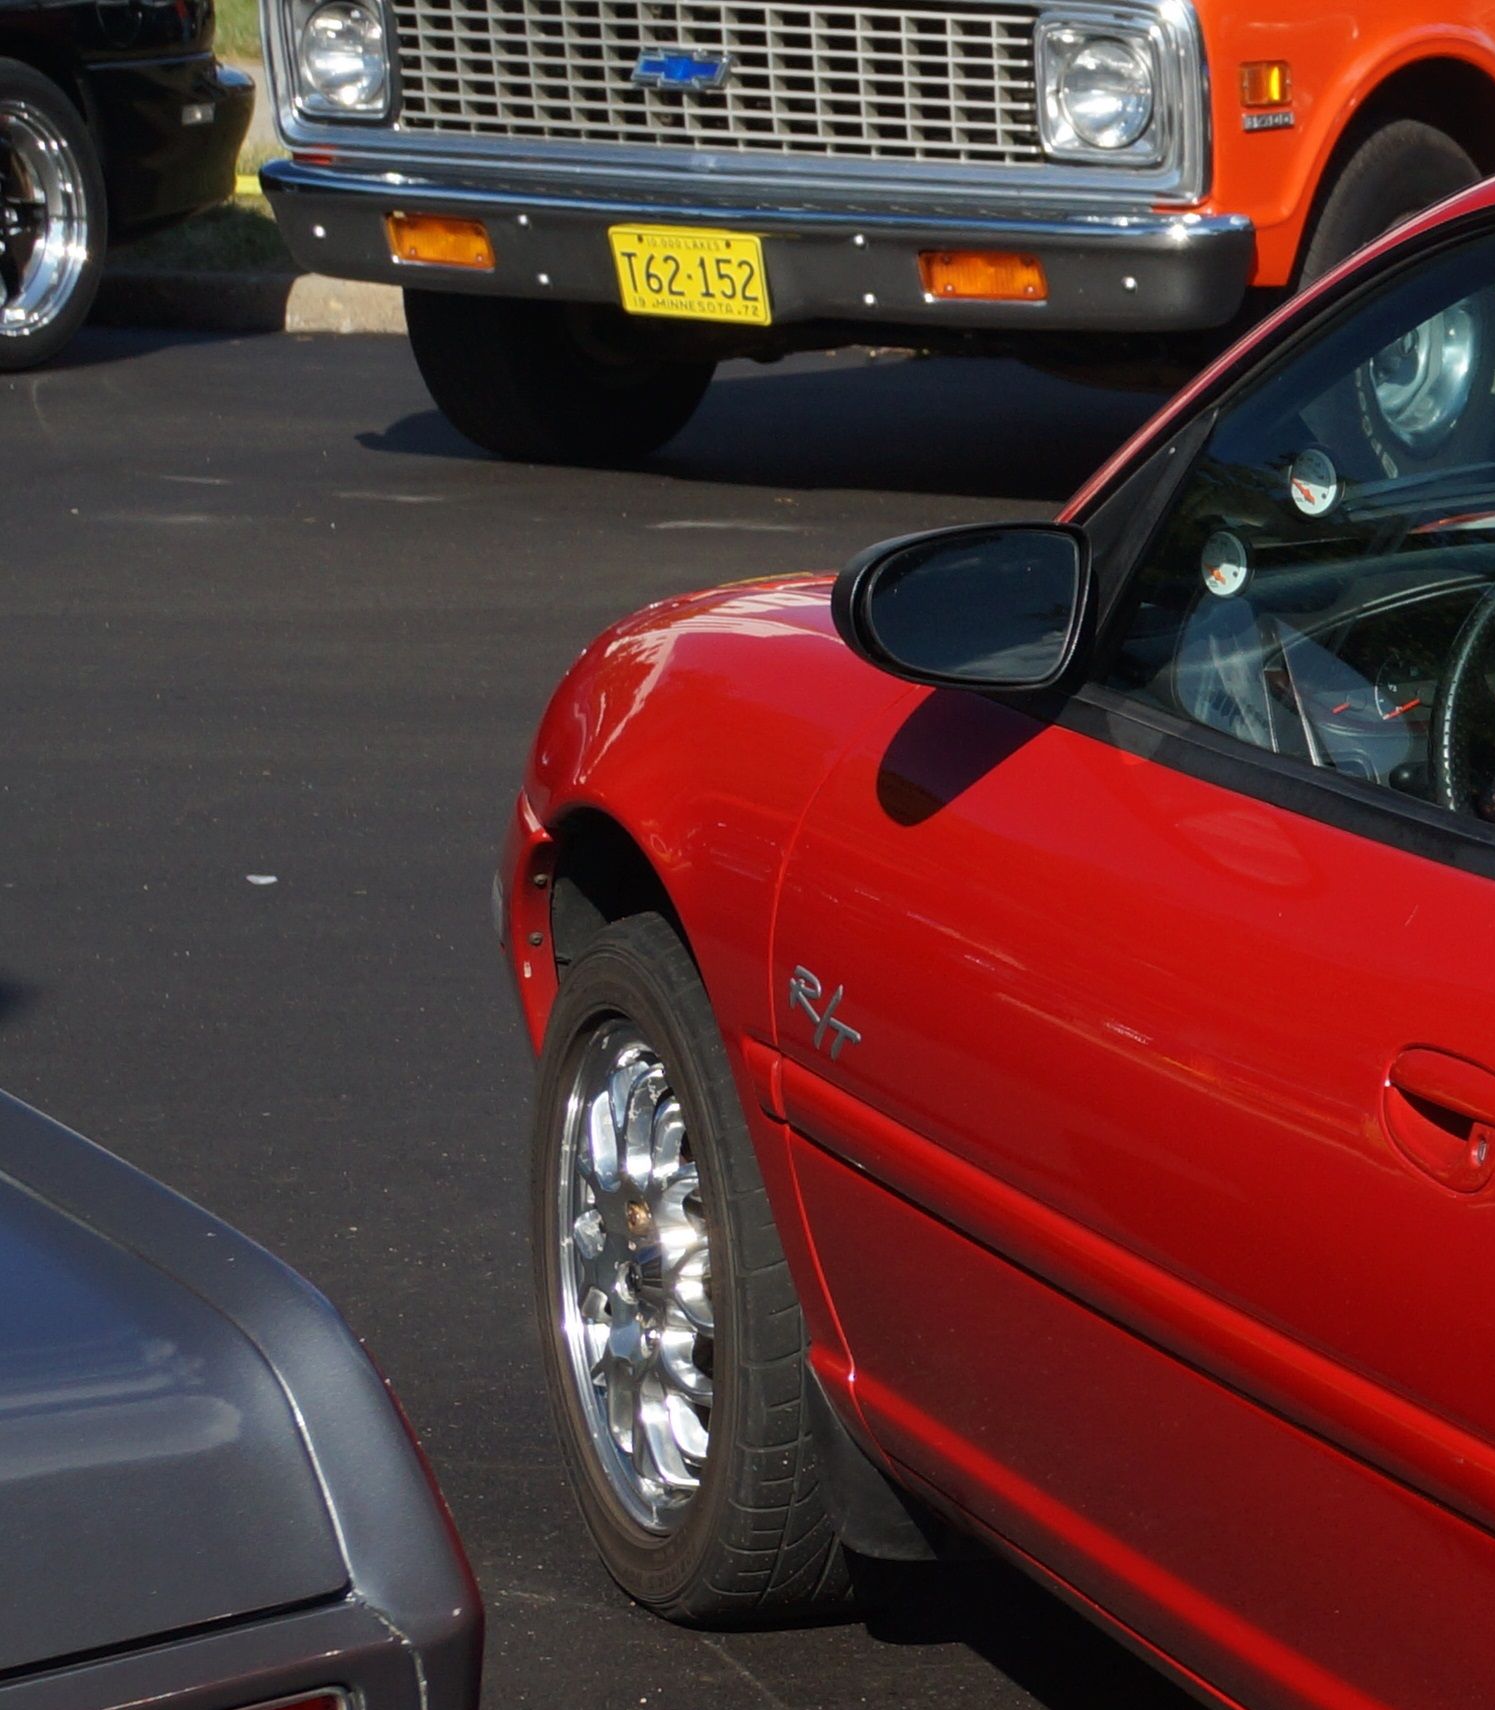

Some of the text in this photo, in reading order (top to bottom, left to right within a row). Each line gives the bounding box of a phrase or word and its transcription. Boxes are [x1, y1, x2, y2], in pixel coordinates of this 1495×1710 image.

[683, 239, 721, 252] LAKES
[653, 298, 734, 315] MINNESOTA
[789, 964, 861, 1062] R/T
